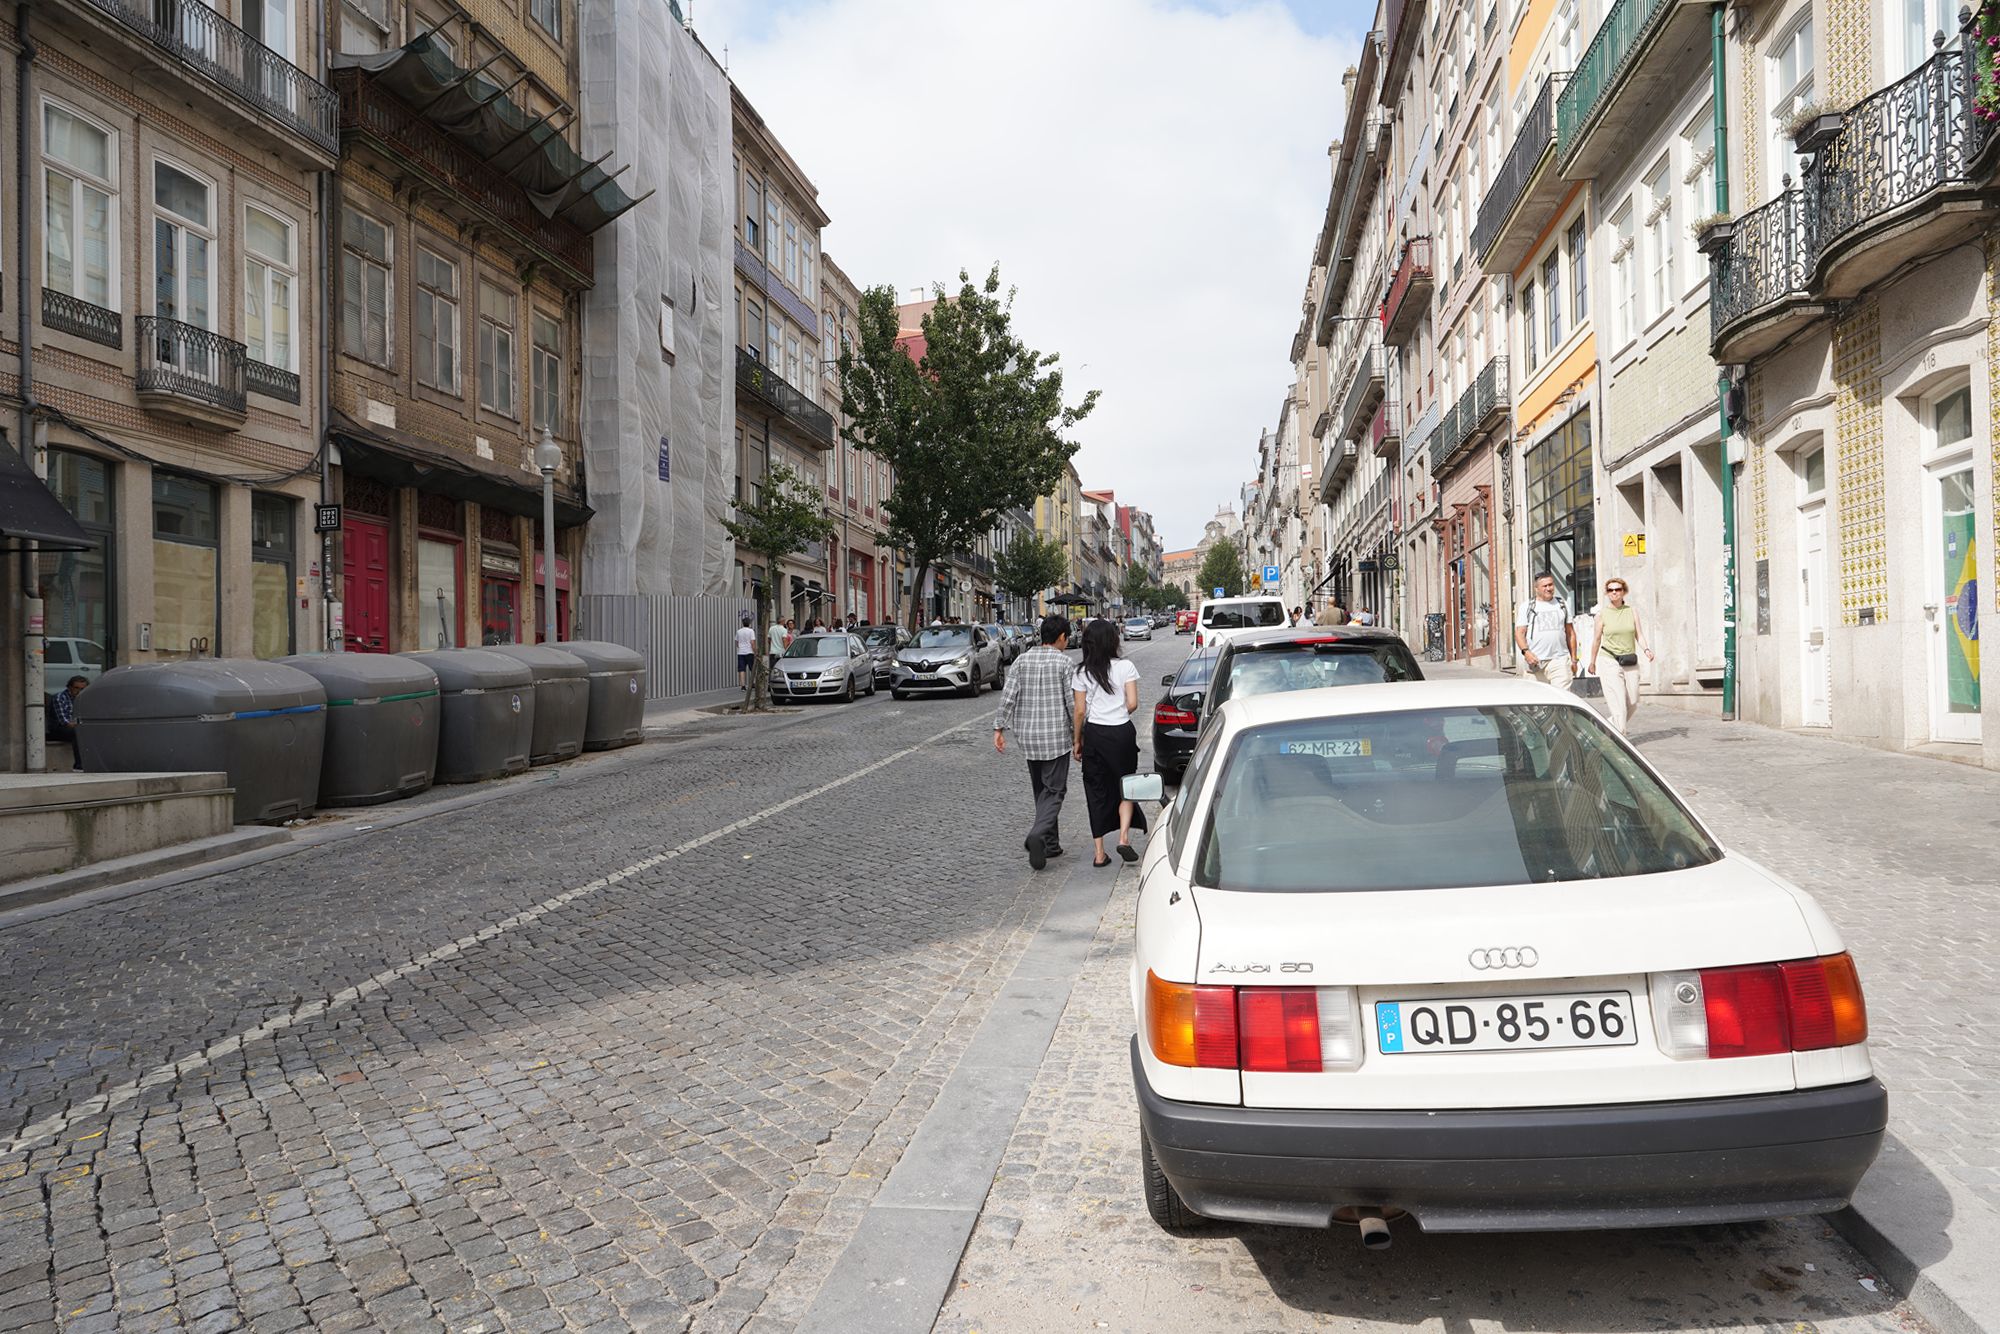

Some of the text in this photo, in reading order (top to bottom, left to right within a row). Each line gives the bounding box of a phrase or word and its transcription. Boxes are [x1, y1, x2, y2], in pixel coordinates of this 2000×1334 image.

[1922, 352, 1936, 371] 118
[1267, 568, 1276, 580] P
[1280, 962, 1313, 973] 80
[1386, 1032, 1396, 1044] P
